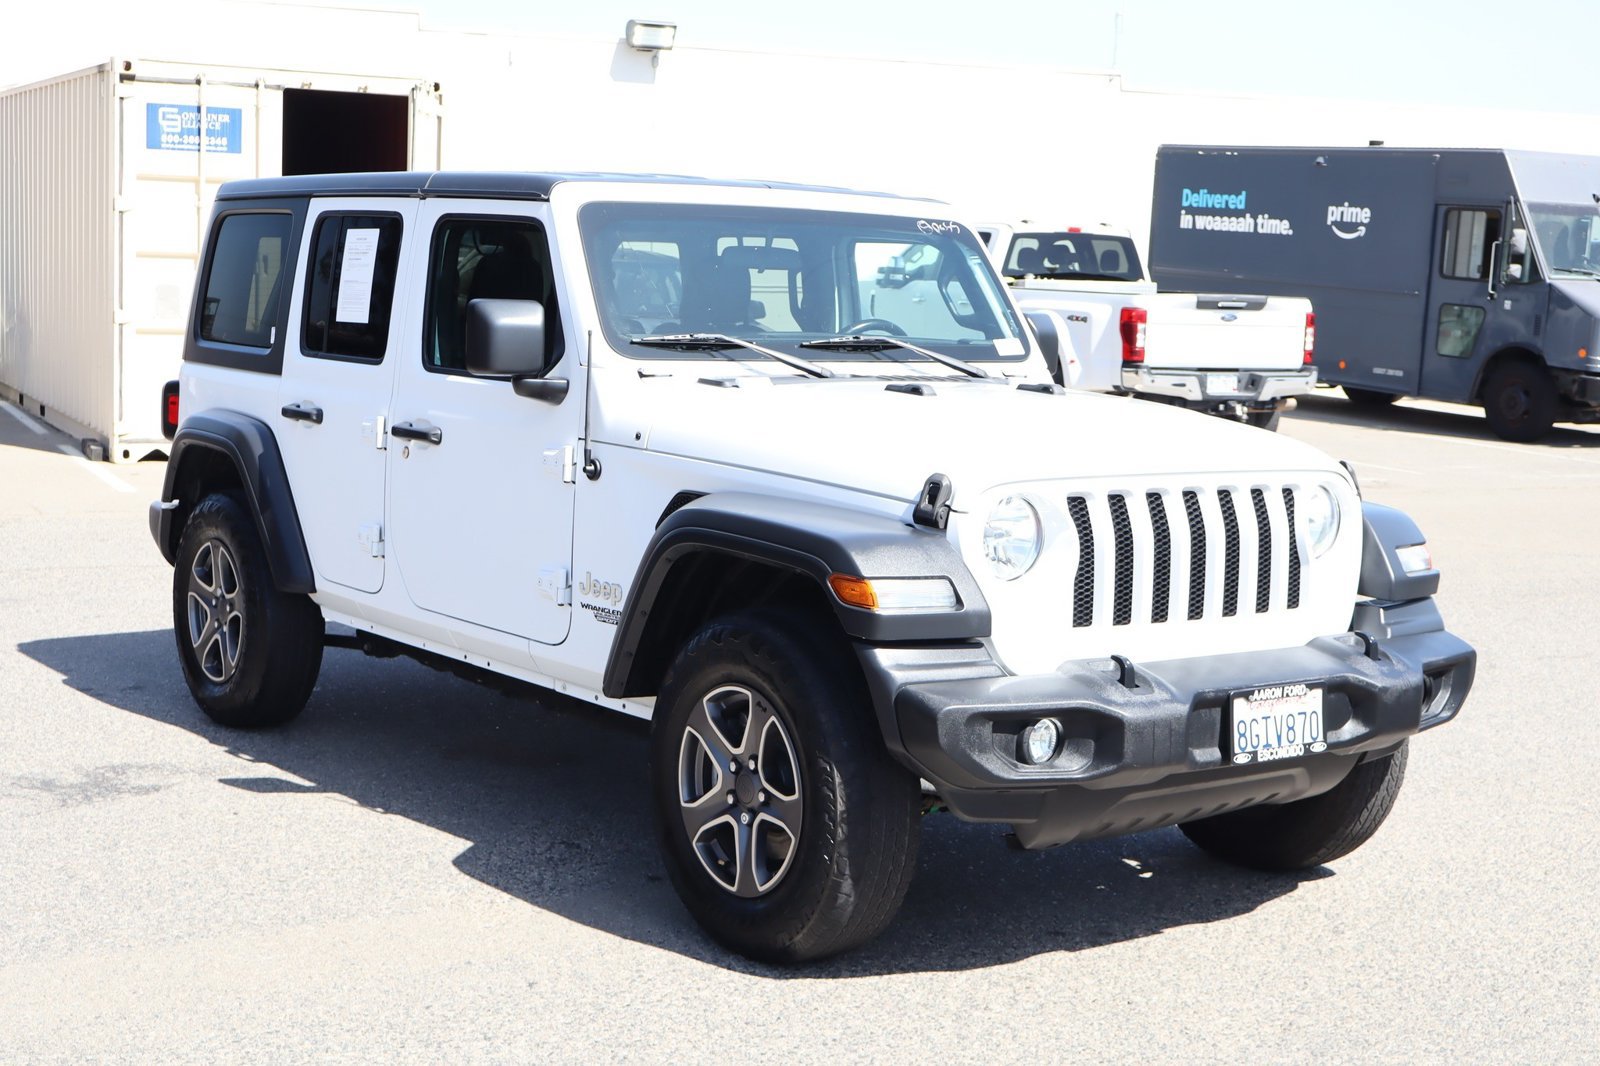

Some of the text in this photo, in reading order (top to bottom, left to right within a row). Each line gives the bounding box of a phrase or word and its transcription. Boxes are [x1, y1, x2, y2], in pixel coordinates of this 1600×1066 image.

[1182, 188, 1246, 209] Delivered
[1180, 210, 1293, 236] in woaaaah time.
[1327, 202, 1371, 225] prime
[578, 571, 623, 606] Jeep
[580, 601, 622, 616] WRANGLER
[1253, 684, 1306, 701] AARON FORD
[1237, 711, 1319, 752] 8GIV870
[1257, 744, 1305, 762] ESCONDIDO
